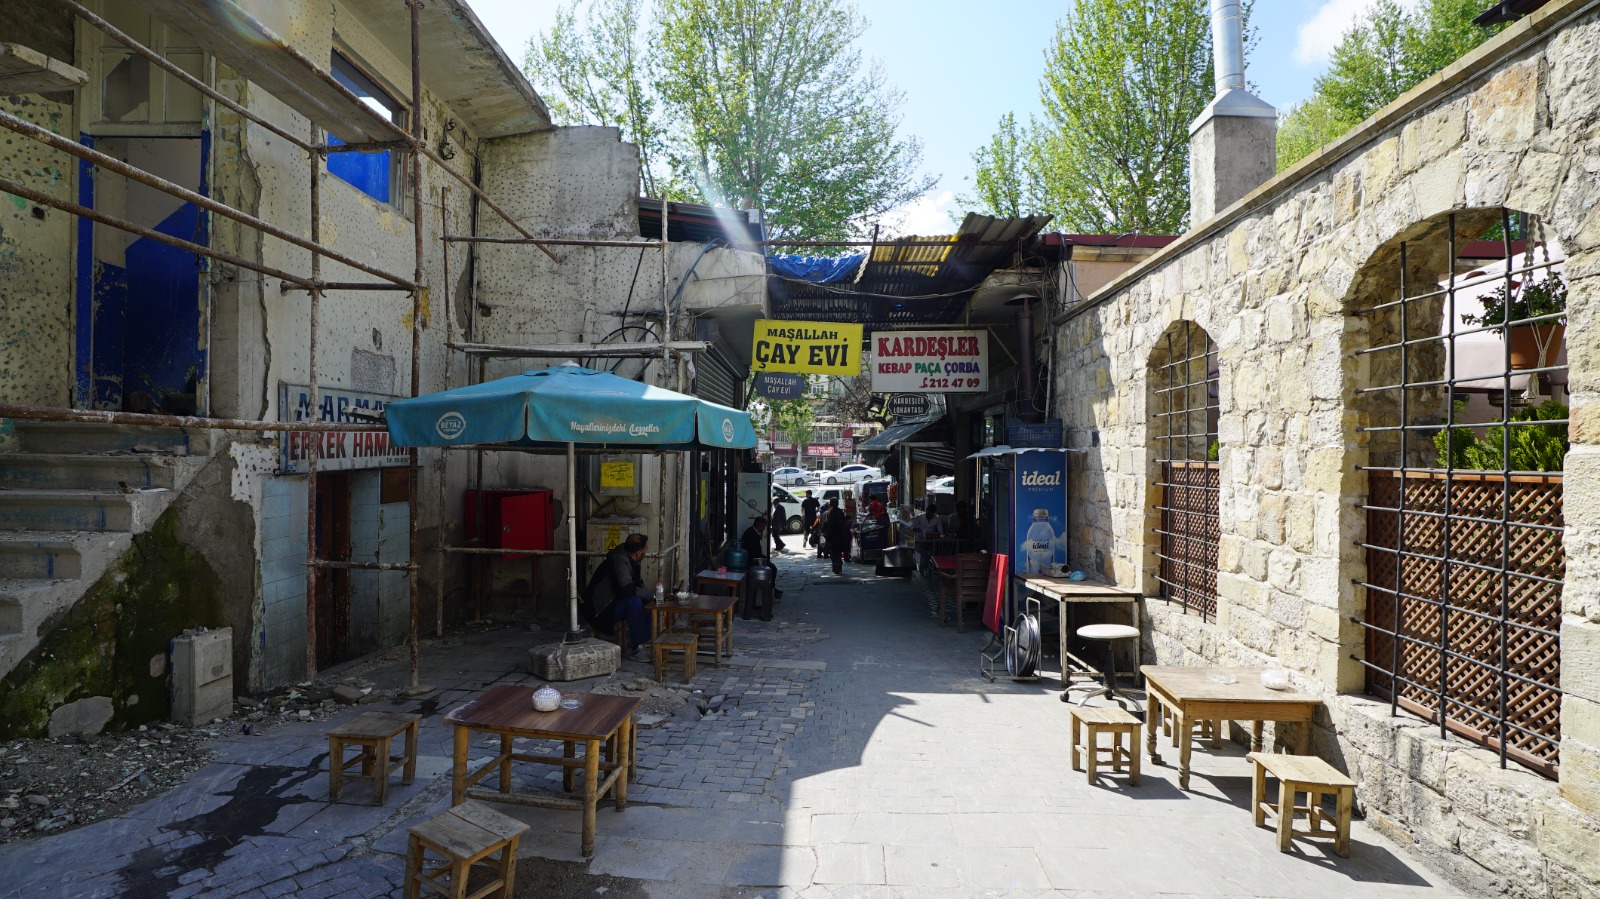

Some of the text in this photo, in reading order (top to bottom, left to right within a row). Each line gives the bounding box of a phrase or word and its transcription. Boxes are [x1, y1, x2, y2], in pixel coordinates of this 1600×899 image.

[767, 328, 838, 342] MAŞALLAH
[756, 338, 849, 369] ÇAY EVİ
[878, 337, 980, 361] KARDEŞLER
[878, 362, 980, 376] KEBAP PAÇA ÇORBA
[764, 376, 797, 386] MAŞALLAH
[929, 378, 980, 388] 212 47 09
[893, 397, 925, 406] KARDEŞLER
[893, 406, 924, 414] LOKANTASI
[440, 421, 462, 429] BEYAZ
[290, 432, 347, 460] ERKEK
[1021, 470, 1061, 486] ideal
